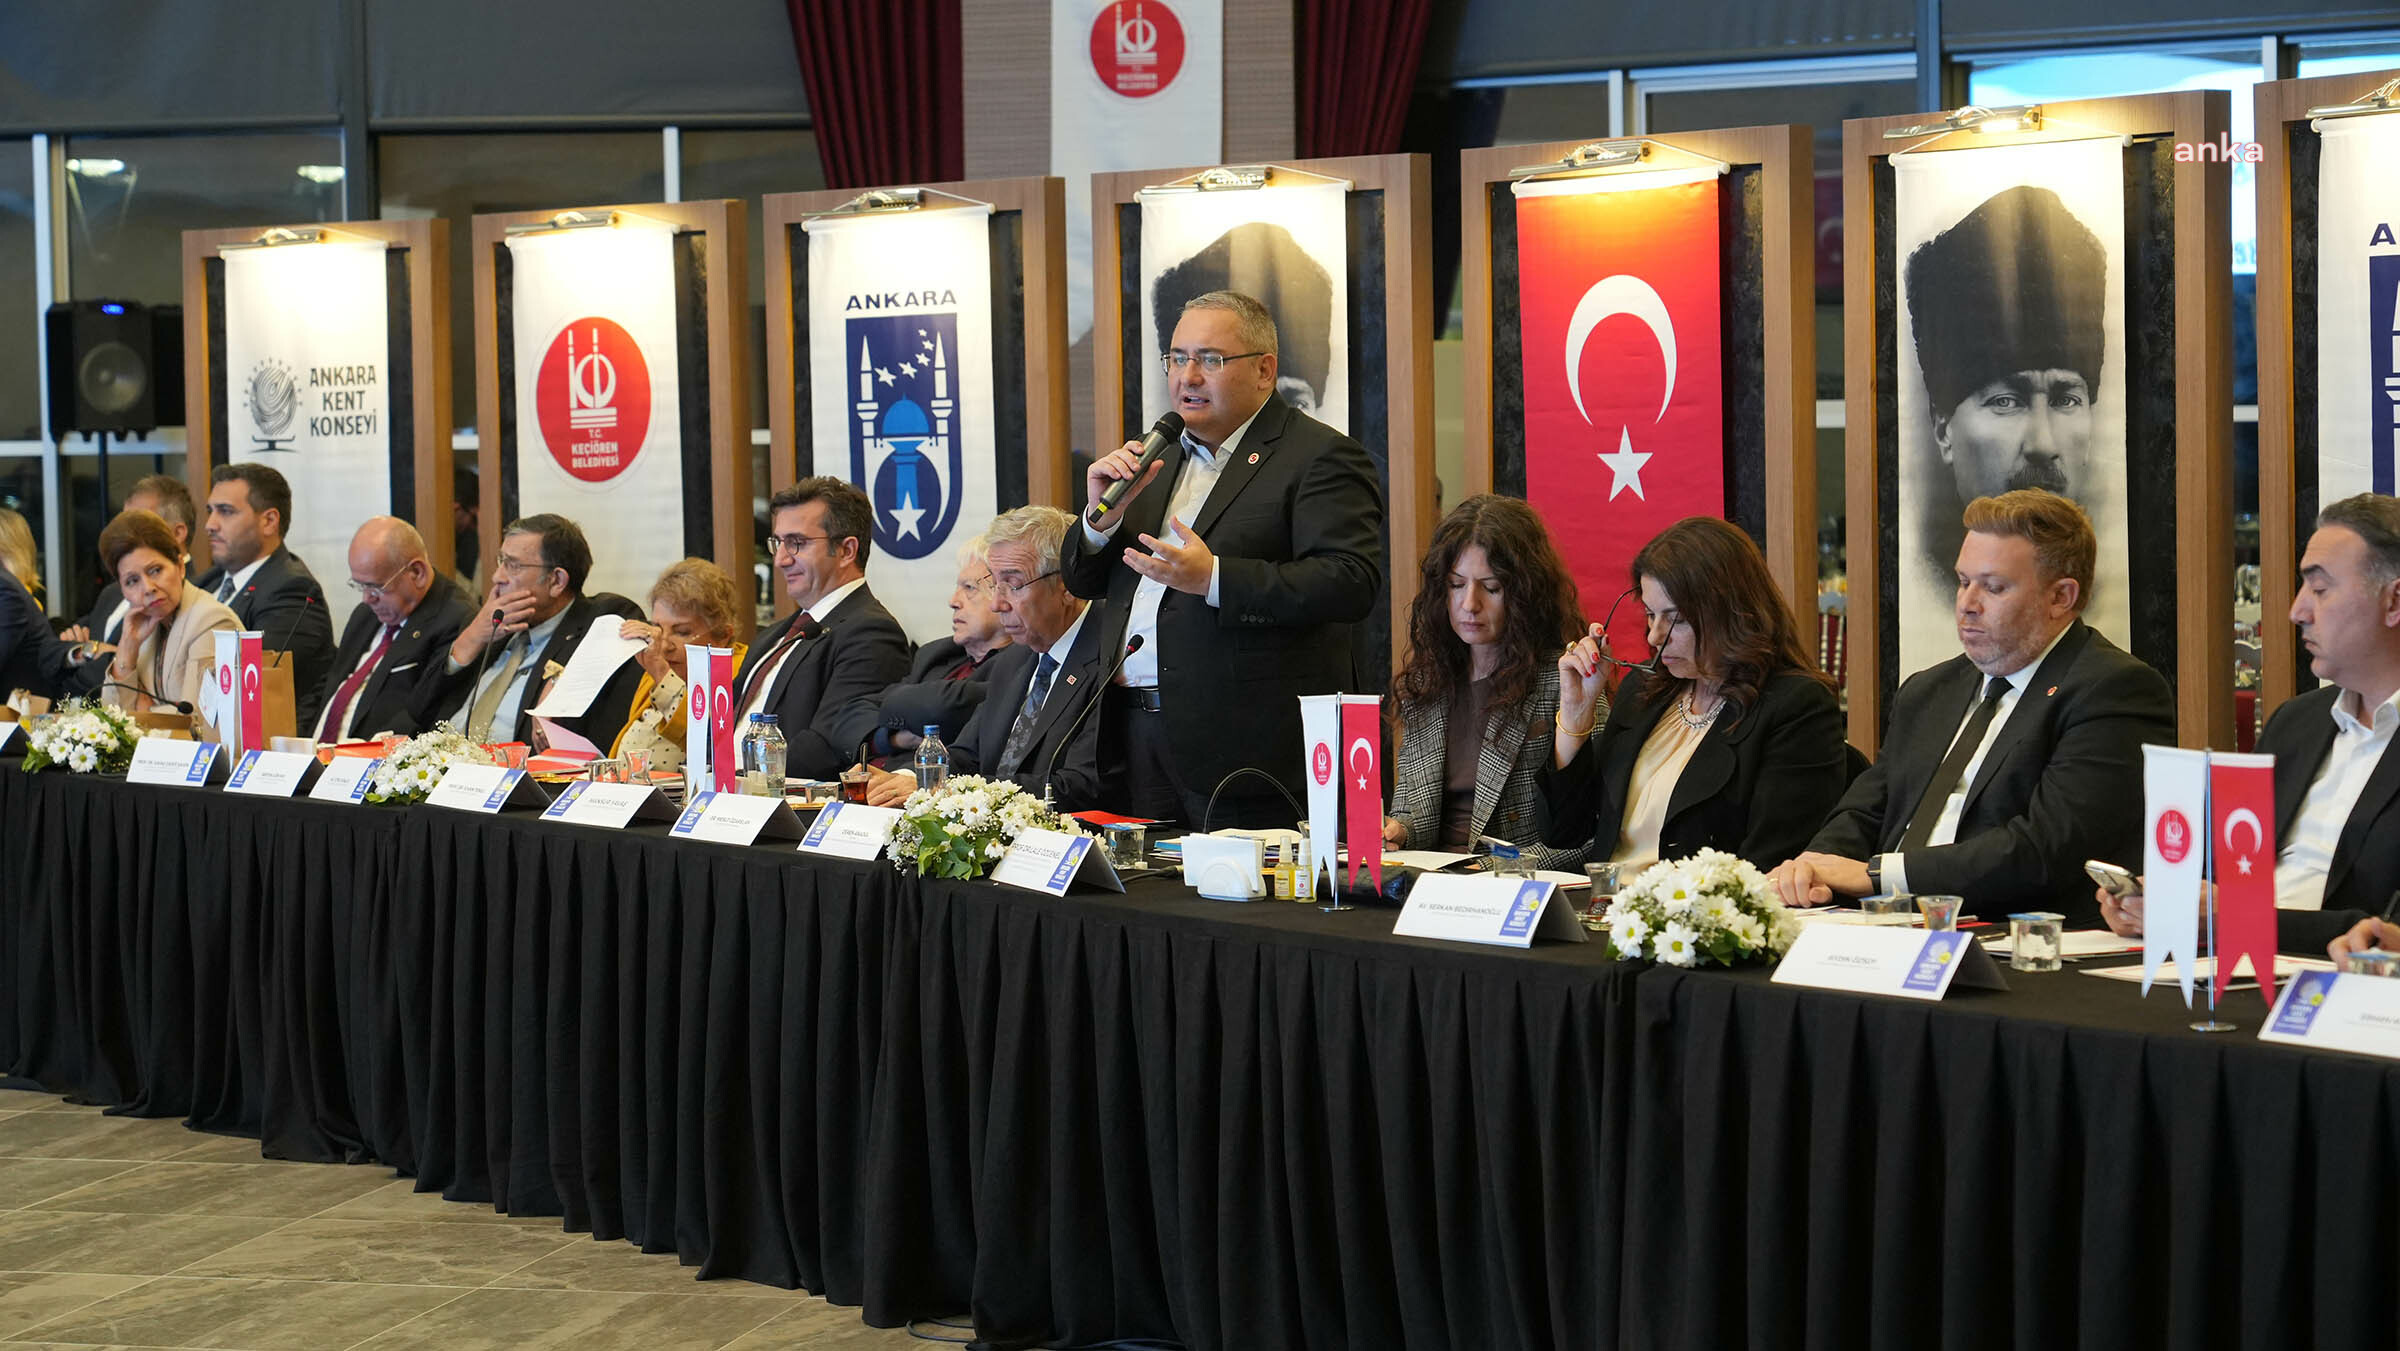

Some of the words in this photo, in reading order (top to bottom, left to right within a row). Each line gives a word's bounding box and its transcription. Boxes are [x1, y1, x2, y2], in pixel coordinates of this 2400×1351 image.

[845, 289, 957, 311] ANKARA
[309, 365, 377, 387] ANKARA
[322, 390, 366, 411] KENT
[310, 408, 377, 437] KONSEYİ
[571, 440, 619, 455] KEÇİÖREN
[572, 455, 619, 468] BELEDİYESİ
